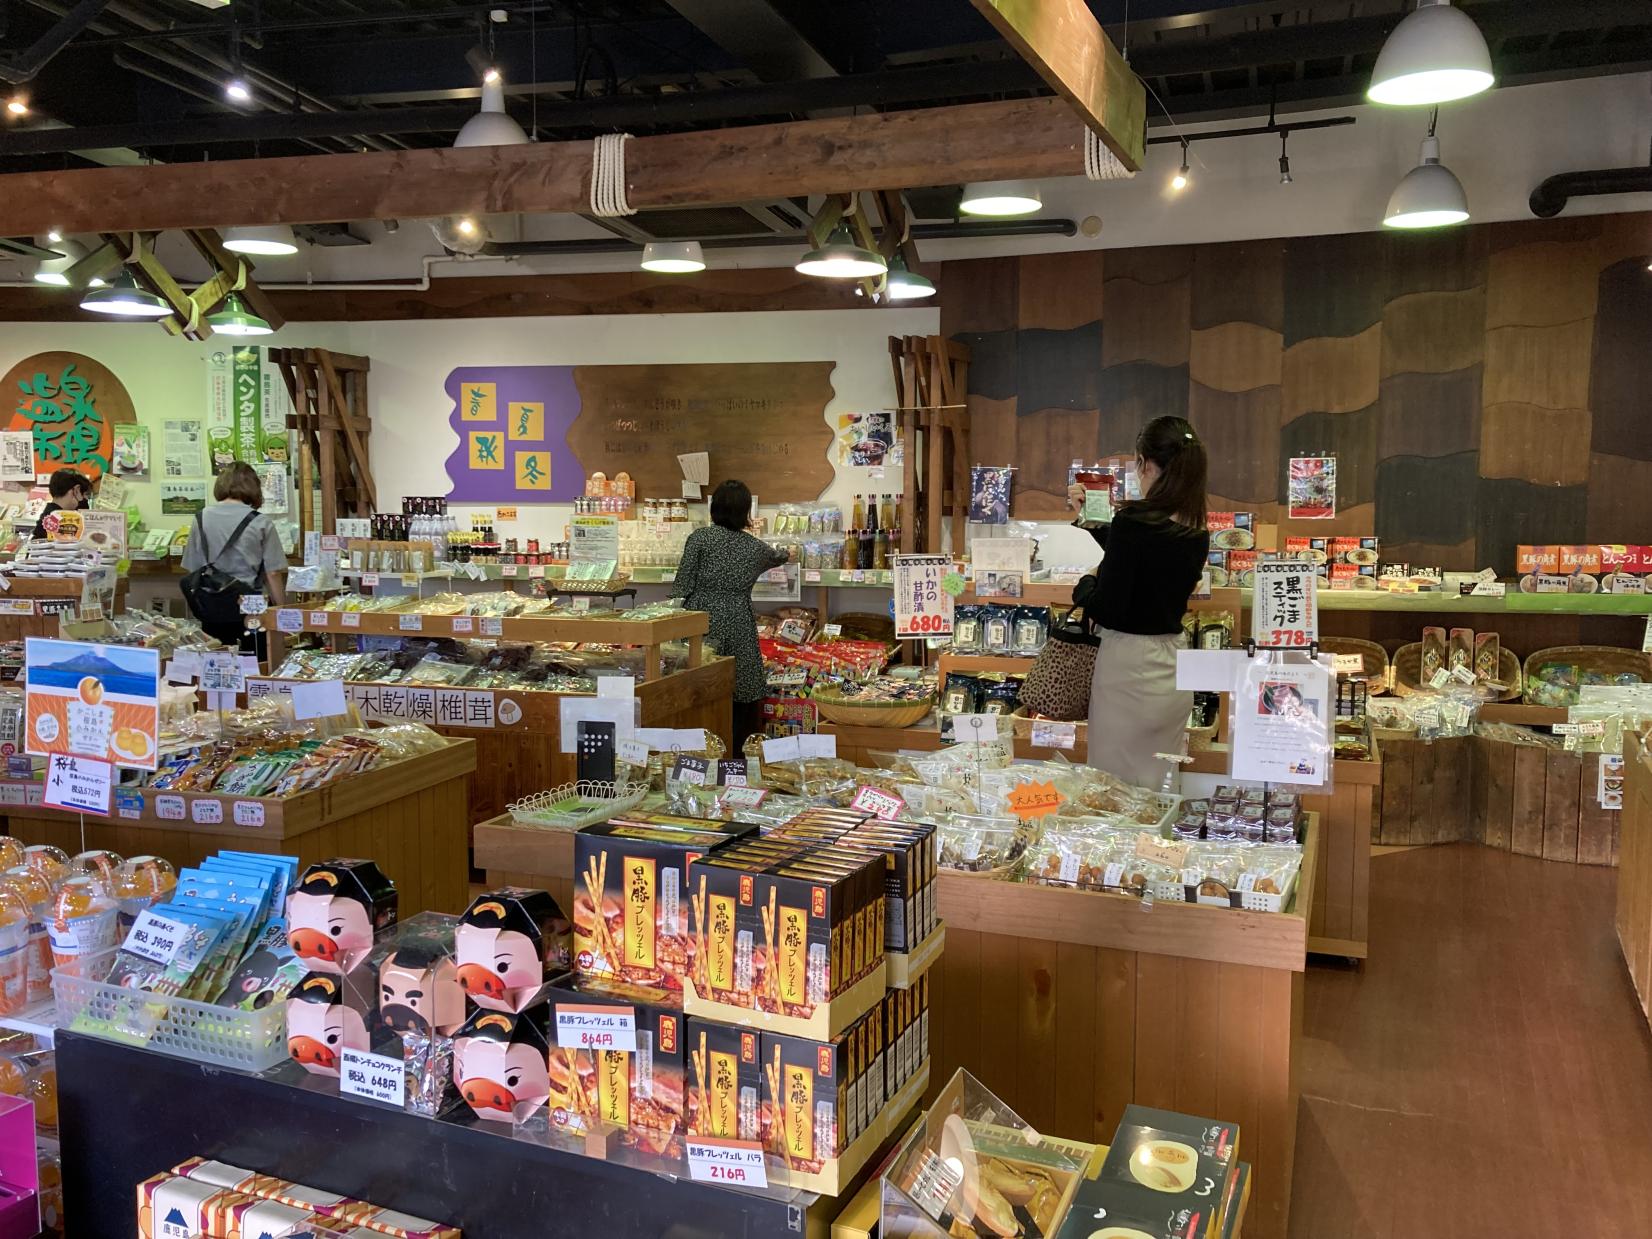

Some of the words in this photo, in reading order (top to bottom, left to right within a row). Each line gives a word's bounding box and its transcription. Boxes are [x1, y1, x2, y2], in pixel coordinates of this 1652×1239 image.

[1602, 553, 1633, 564] とんこつ
[926, 568, 937, 601] いかの
[1272, 581, 1286, 627] スティック
[1286, 576, 1304, 623] 黒ごま
[910, 614, 942, 632] 680
[1271, 630, 1305, 646] 378
[742, 878, 752, 903] 鹿児島
[814, 889, 825, 915] 鹿児島
[631, 866, 650, 960] 黒豚プレッツェル
[714, 903, 730, 983] 黒豚プレッツェル
[785, 914, 802, 998] 黒豚プレッツェル
[559, 1015, 614, 1026] 黒豚プレッツェル
[581, 1033, 613, 1045] 864円
[662, 1019, 674, 1050] 鹿児島
[743, 1035, 753, 1060] 鹿児島
[819, 1048, 830, 1075] 鹿児島
[371, 1075, 397, 1091] 648円
[604, 1050, 623, 1120] 豚プレッツェル
[716, 1060, 733, 1137] 黒豚プレッツェル
[790, 1073, 808, 1152] 黒豚プレッツェル
[689, 1147, 742, 1161] 黒豚プレッツェル
[710, 1165, 746, 1180] 216円
